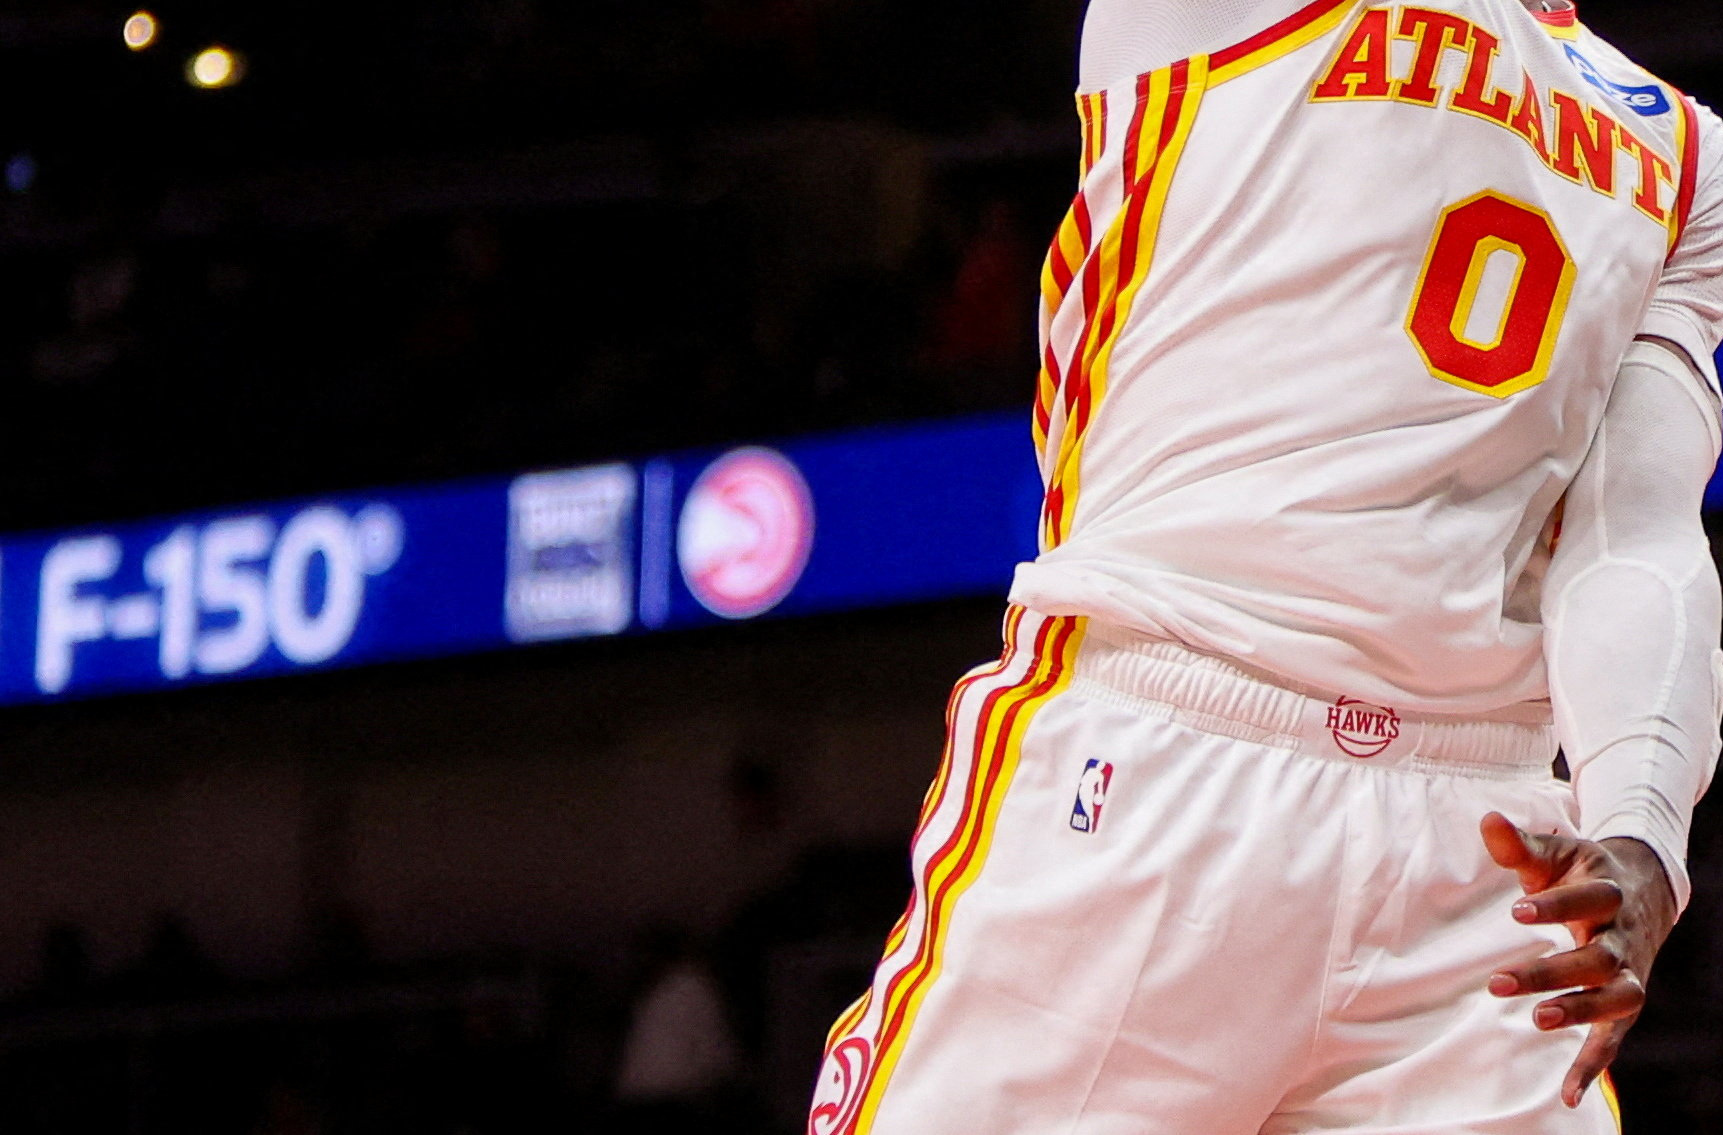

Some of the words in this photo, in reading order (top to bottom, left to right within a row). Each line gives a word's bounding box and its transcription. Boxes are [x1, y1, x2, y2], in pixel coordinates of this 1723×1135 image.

[1307, 5, 1678, 231] ATLANT
[1404, 188, 1578, 400] 0
[1325, 706, 1401, 739] HAWKS
